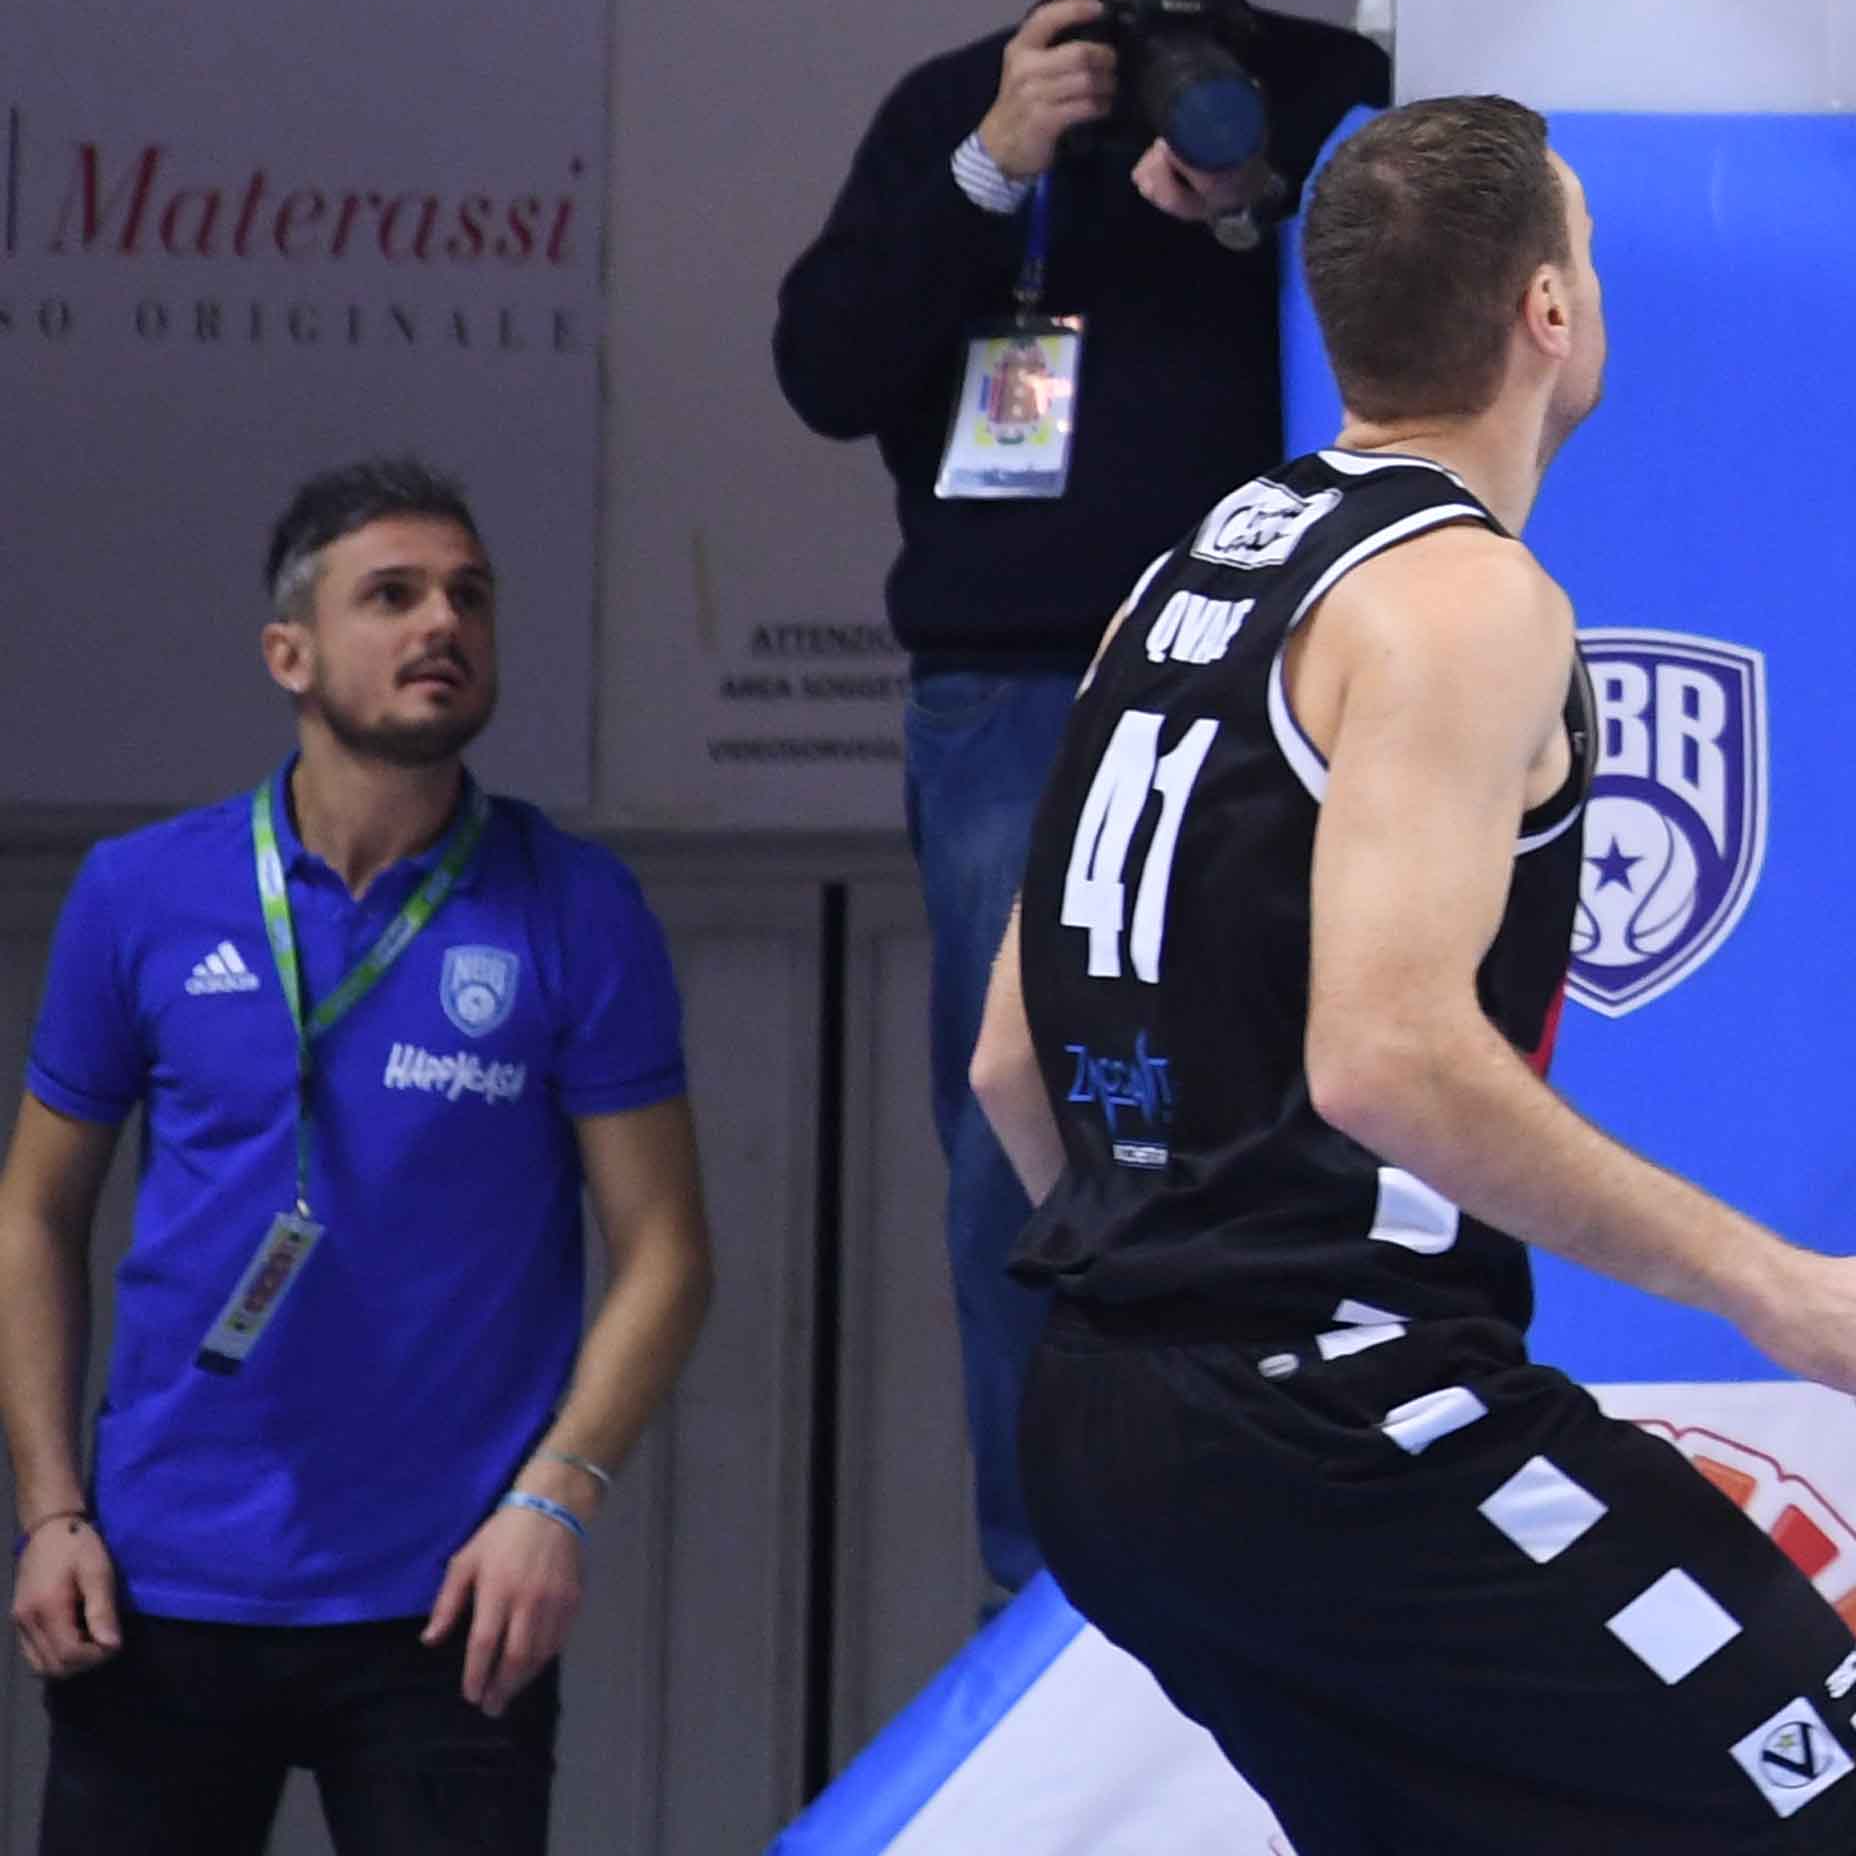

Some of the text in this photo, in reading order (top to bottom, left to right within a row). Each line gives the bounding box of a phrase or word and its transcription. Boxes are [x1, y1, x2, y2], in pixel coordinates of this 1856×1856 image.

[50, 143, 586, 266] Materassi
[134, 297, 592, 355] ORIGINALE
[1596, 660, 1729, 856] BB
[1060, 710, 1220, 984] 41
